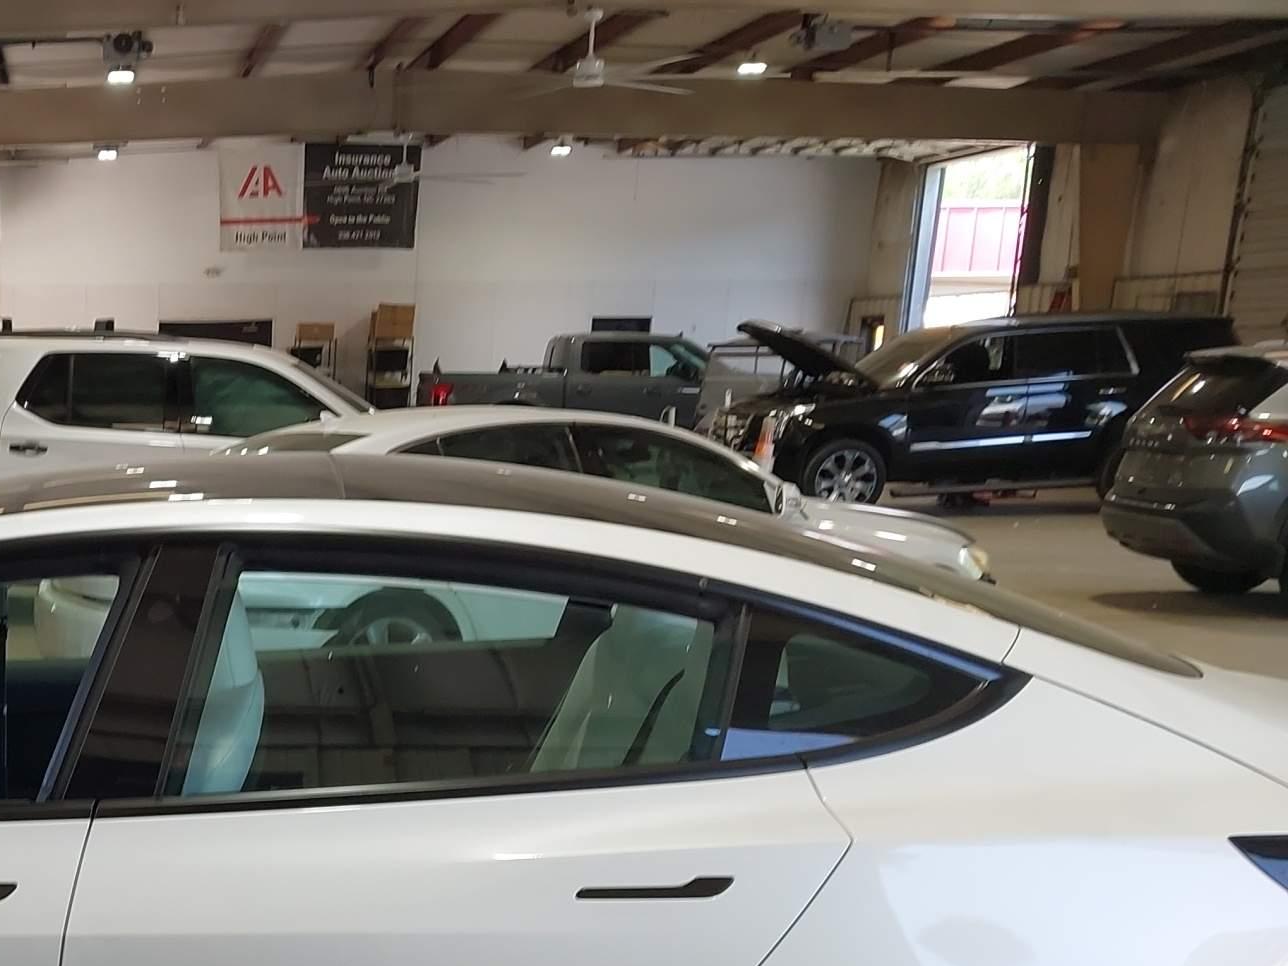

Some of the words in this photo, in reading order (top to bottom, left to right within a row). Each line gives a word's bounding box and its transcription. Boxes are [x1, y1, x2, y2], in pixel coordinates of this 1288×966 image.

[334, 151, 392, 167] Insurance
[322, 165, 349, 181] Auto
[351, 165, 396, 181] Auction
[329, 213, 347, 227] Open
[235, 231, 259, 245] High
[261, 230, 286, 244] Point
